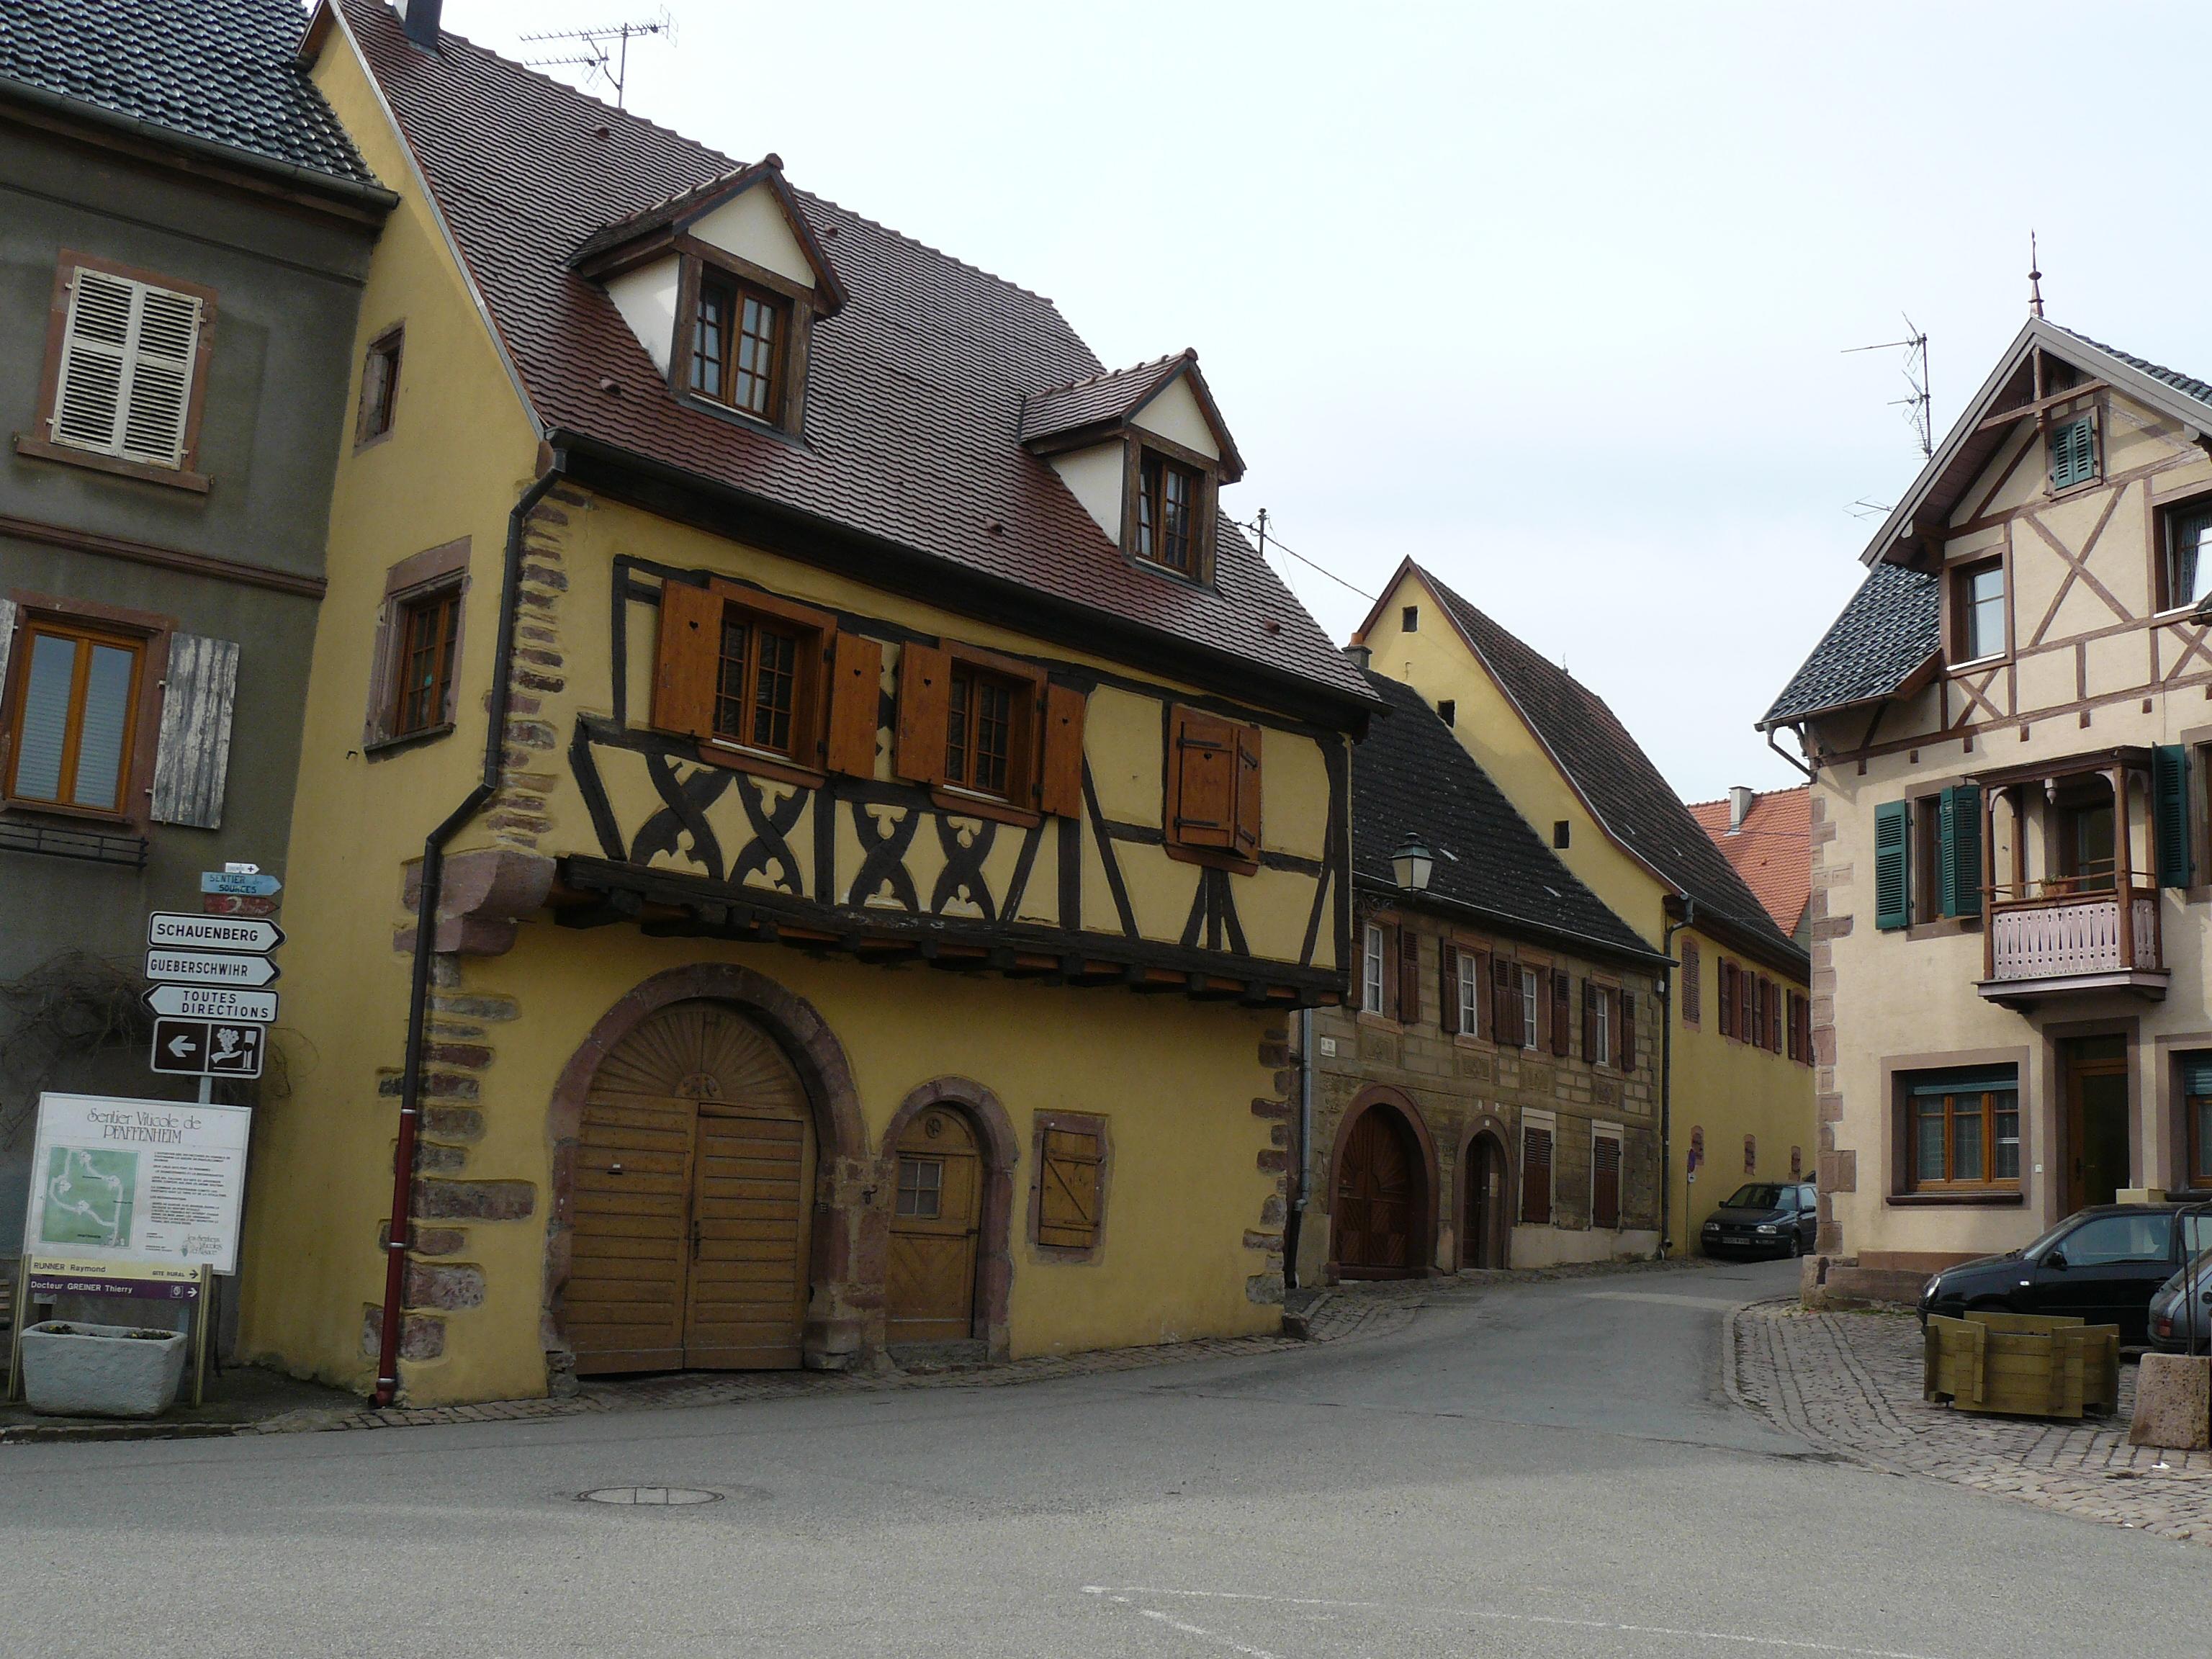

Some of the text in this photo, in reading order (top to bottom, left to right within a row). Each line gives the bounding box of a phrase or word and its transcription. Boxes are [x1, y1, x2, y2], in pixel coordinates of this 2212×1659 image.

[210, 875, 246, 884] SENTIER
[219, 884, 257, 893] SOURCES
[157, 923, 258, 941] SCHAUENBERG
[150, 958, 248, 976] GUEBERSCHWIHR
[183, 990, 237, 1004] TOUTES
[181, 1002, 269, 1018] DIRECTIONS
[87, 1107, 202, 1129] Sentier Viticole de
[103, 1125, 182, 1143] PFAFFENHEIM
[33, 1262, 65, 1270] RUNNER
[70, 1264, 106, 1273] Raymond
[30, 1280, 132, 1294] Docteur GREINER Thierry
